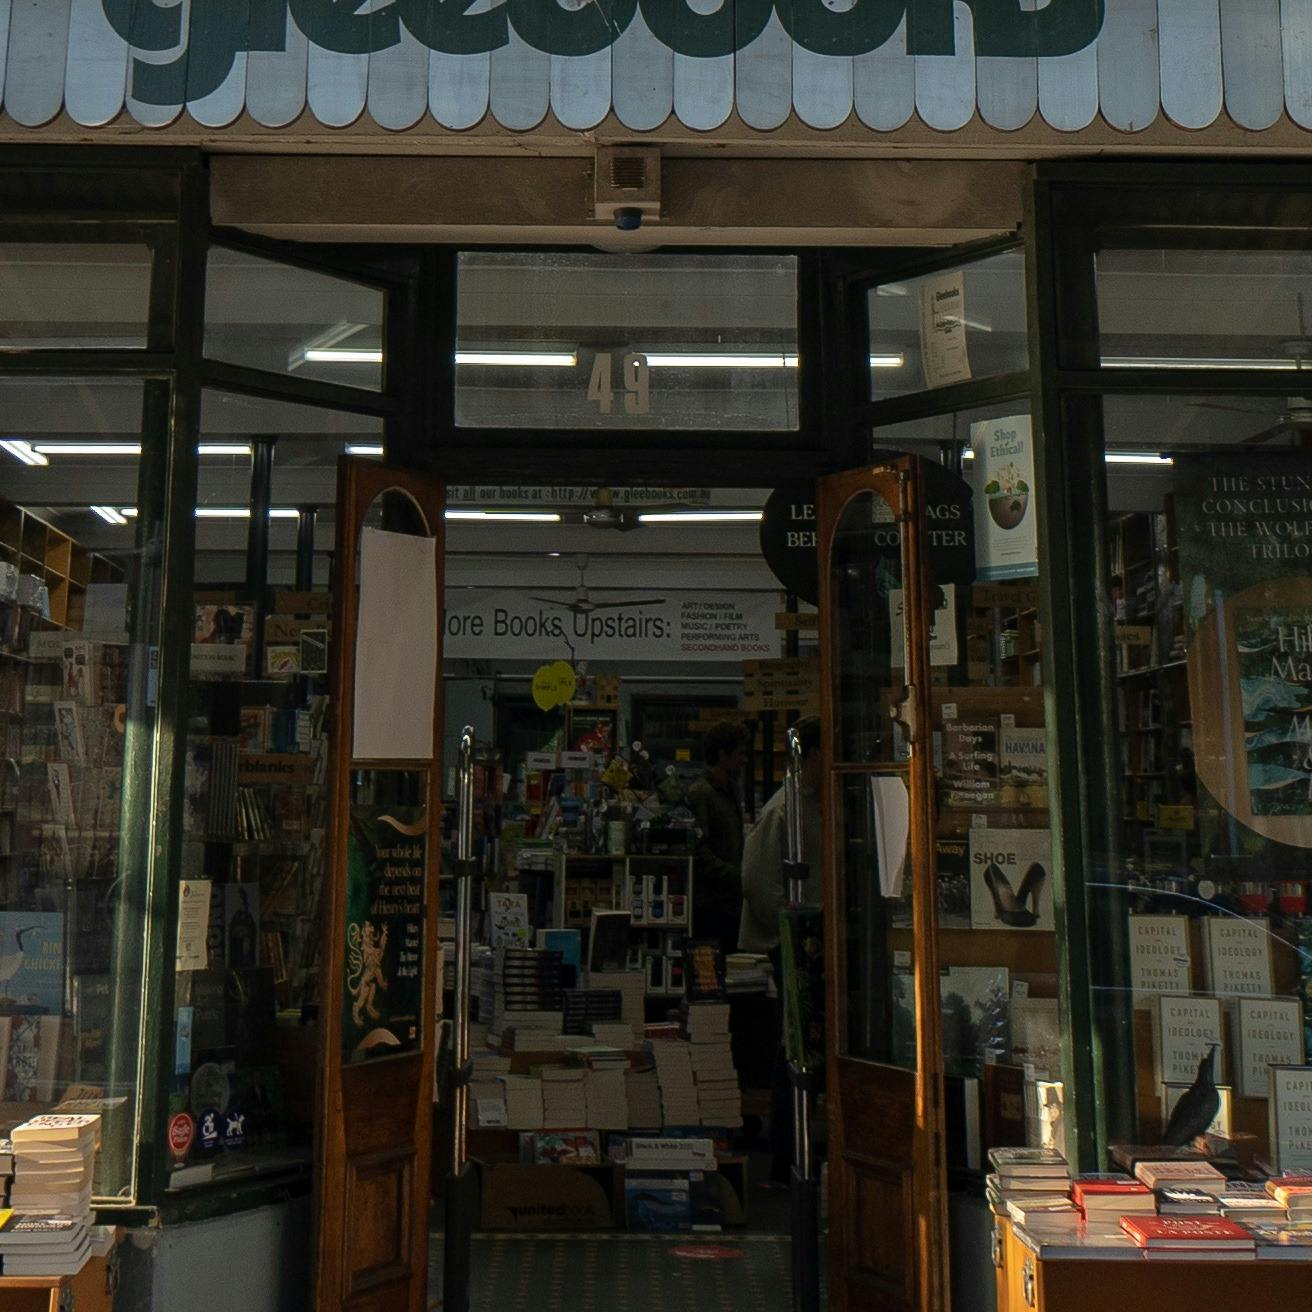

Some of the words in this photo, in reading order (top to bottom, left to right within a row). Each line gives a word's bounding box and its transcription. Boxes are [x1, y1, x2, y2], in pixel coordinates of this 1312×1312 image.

[587, 353, 649, 414] 49
[994, 429, 1017, 443] Shop
[990, 443, 1024, 458] Ethical!
[1209, 477, 1250, 492] THE
[446, 488, 460, 499] sit
[464, 488, 476, 501] all
[479, 490, 497, 500] our
[499, 488, 529, 500] books
[532, 489, 543, 500] at
[926, 504, 961, 520] AGS
[1207, 521, 1248, 537] THE
[681, 602, 698, 610] ART
[704, 602, 735, 610] DESIGN
[681, 612, 717, 620] FASHION
[445, 610, 484, 637] ore
[494, 609, 563, 638] Books
[572, 609, 671, 644] Upstairs:
[681, 633, 736, 641] PERFORMING
[738, 633, 760, 641] ARTS
[741, 644, 770, 652] BOOKS
[946, 723, 995, 732] Barbarian
[959, 734, 983, 745] Days
[1005, 742, 1046, 754] HAVANA
[959, 752, 992, 763] Surfing
[962, 763, 981, 771] Life
[953, 779, 990, 788] William
[973, 852, 1017, 865] SHOE
[1138, 926, 1176, 937] CAPITAL
[1219, 928, 1258, 938] CAPITAL
[1136, 944, 1181, 955] IDEOLOGY
[1217, 947, 1263, 957] IDEOLOGY
[1141, 967, 1179, 978] THOMAS
[1223, 970, 1261, 980] THOMAS
[1141, 979, 1179, 990] PIKETTY
[1170, 1007, 1210, 1019] CAPITAL
[1250, 1010, 1290, 1022] CAPITAL
[1168, 1027, 1215, 1038] IDEOLOGY
[1248, 1029, 1294, 1040] IDEOLOGY
[1173, 1050, 1203, 1061] THOM
[1252, 1053, 1292, 1064] THOMAS
[1173, 1063, 1199, 1074] PIKE
